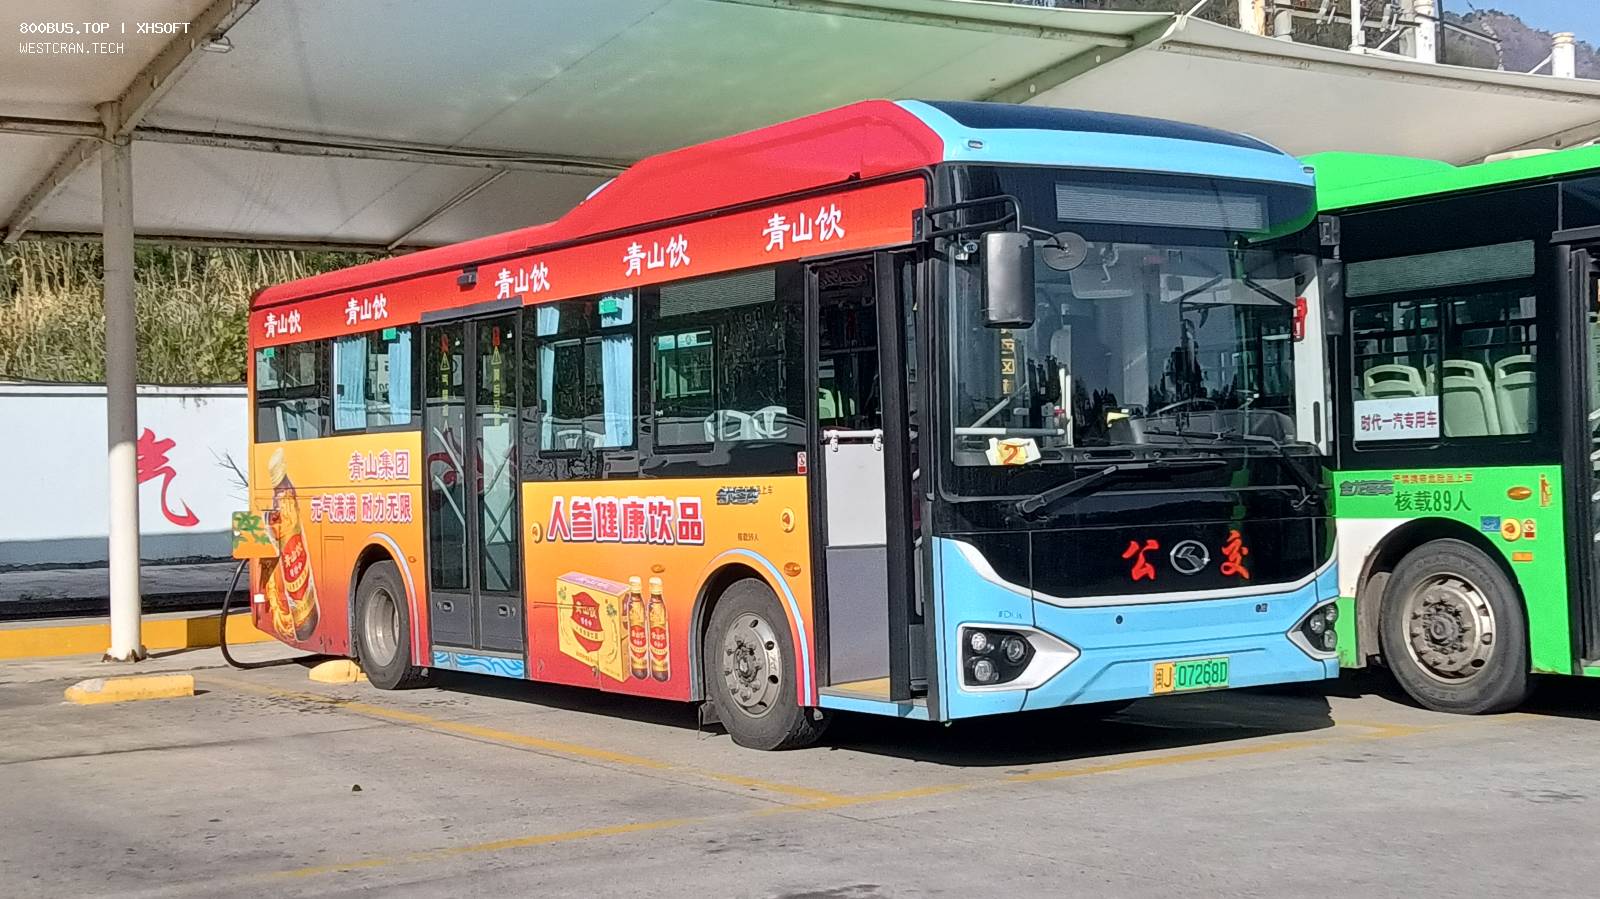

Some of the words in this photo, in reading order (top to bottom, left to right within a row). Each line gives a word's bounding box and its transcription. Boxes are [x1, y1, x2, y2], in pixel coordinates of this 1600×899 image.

[763, 203, 846, 252] 青山饮
[623, 234, 690, 278] 青山饮
[495, 262, 550, 299] 青山饮
[264, 309, 302, 338] 青山饮
[345, 293, 388, 325] 青山饮
[1361, 410, 1438, 432] 时代一汽专用车
[349, 451, 409, 479] 青山集团
[1003, 444, 1018, 465] 2
[311, 494, 357, 522] 元气满满
[361, 493, 412, 522] 耐力无限
[1395, 490, 1472, 511] 核载89人
[547, 496, 704, 545] 人参健康饮品
[1122, 539, 1159, 580] 公
[1220, 530, 1249, 579] 交
[1178, 661, 1228, 687] 07268D
